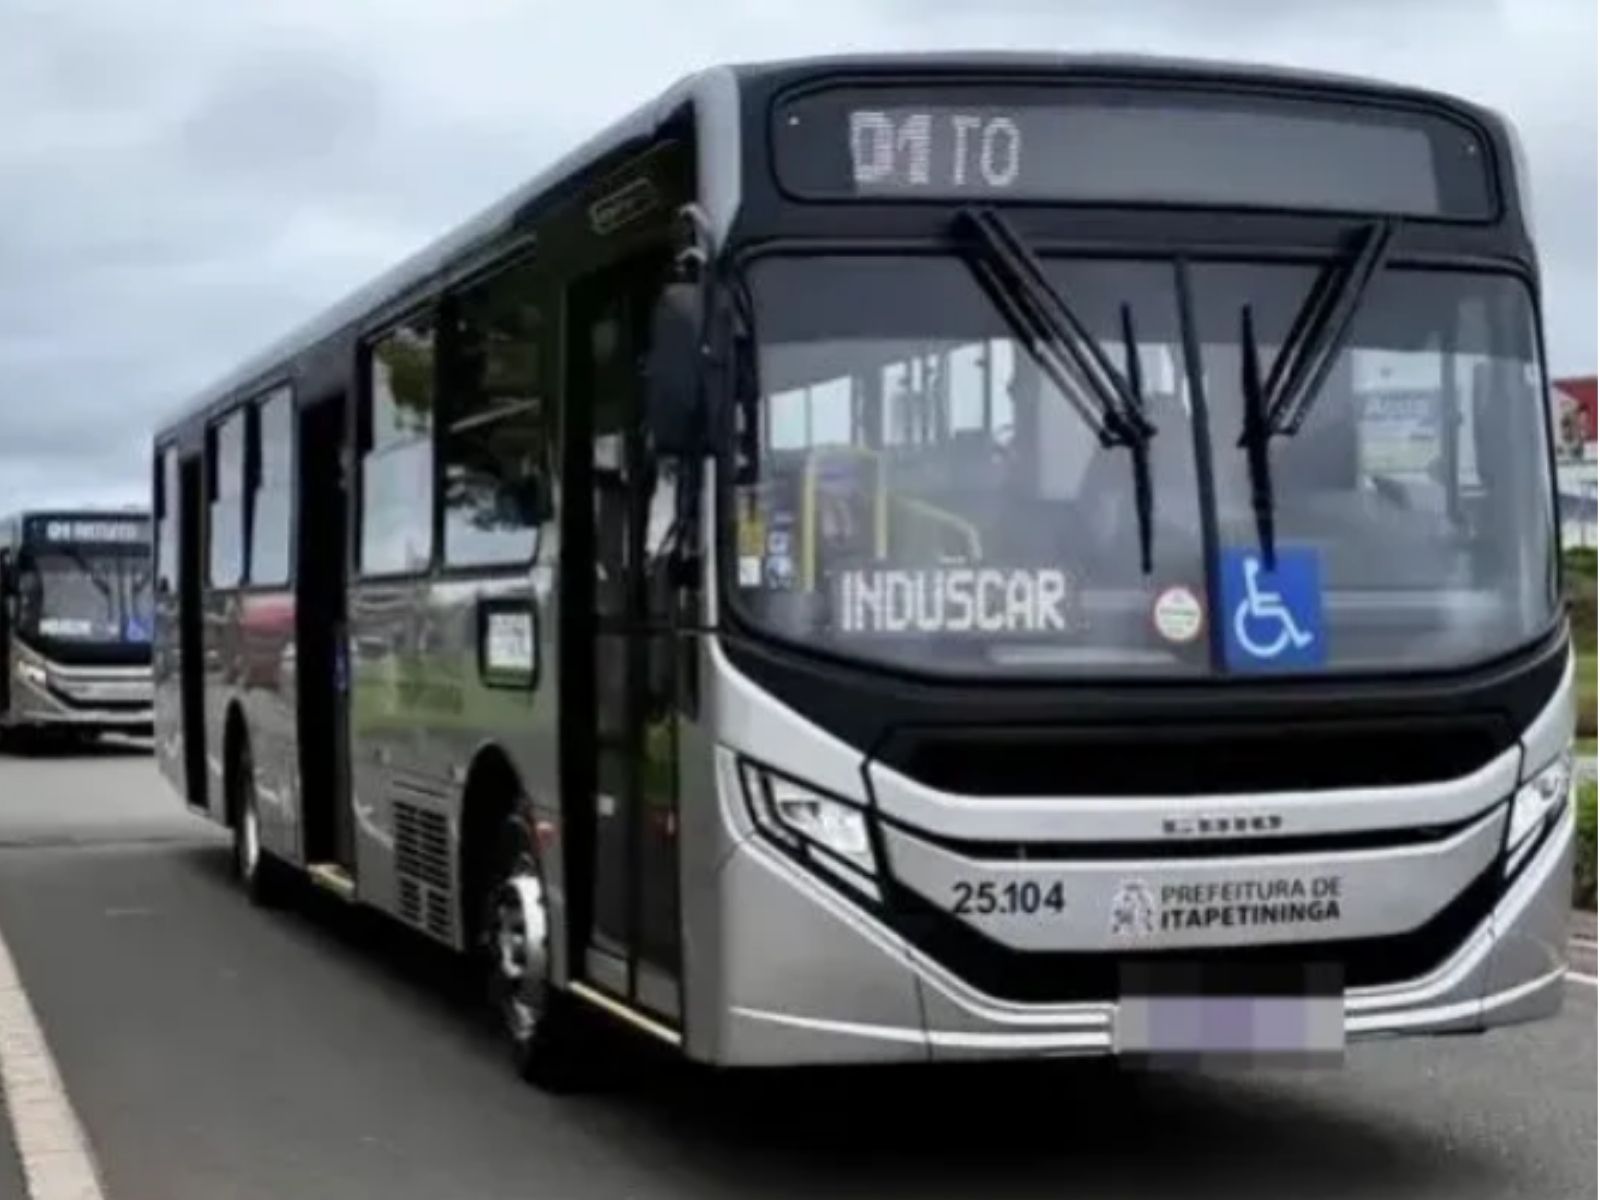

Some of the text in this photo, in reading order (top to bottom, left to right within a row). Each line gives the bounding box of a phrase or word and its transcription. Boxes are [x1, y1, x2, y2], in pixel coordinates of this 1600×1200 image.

[842, 569, 1065, 631] INDUSCAR
[951, 880, 1066, 914] 25.104
[1160, 876, 1342, 904] PREFEITURA DE
[1160, 899, 1341, 930] ITAPETININGA
